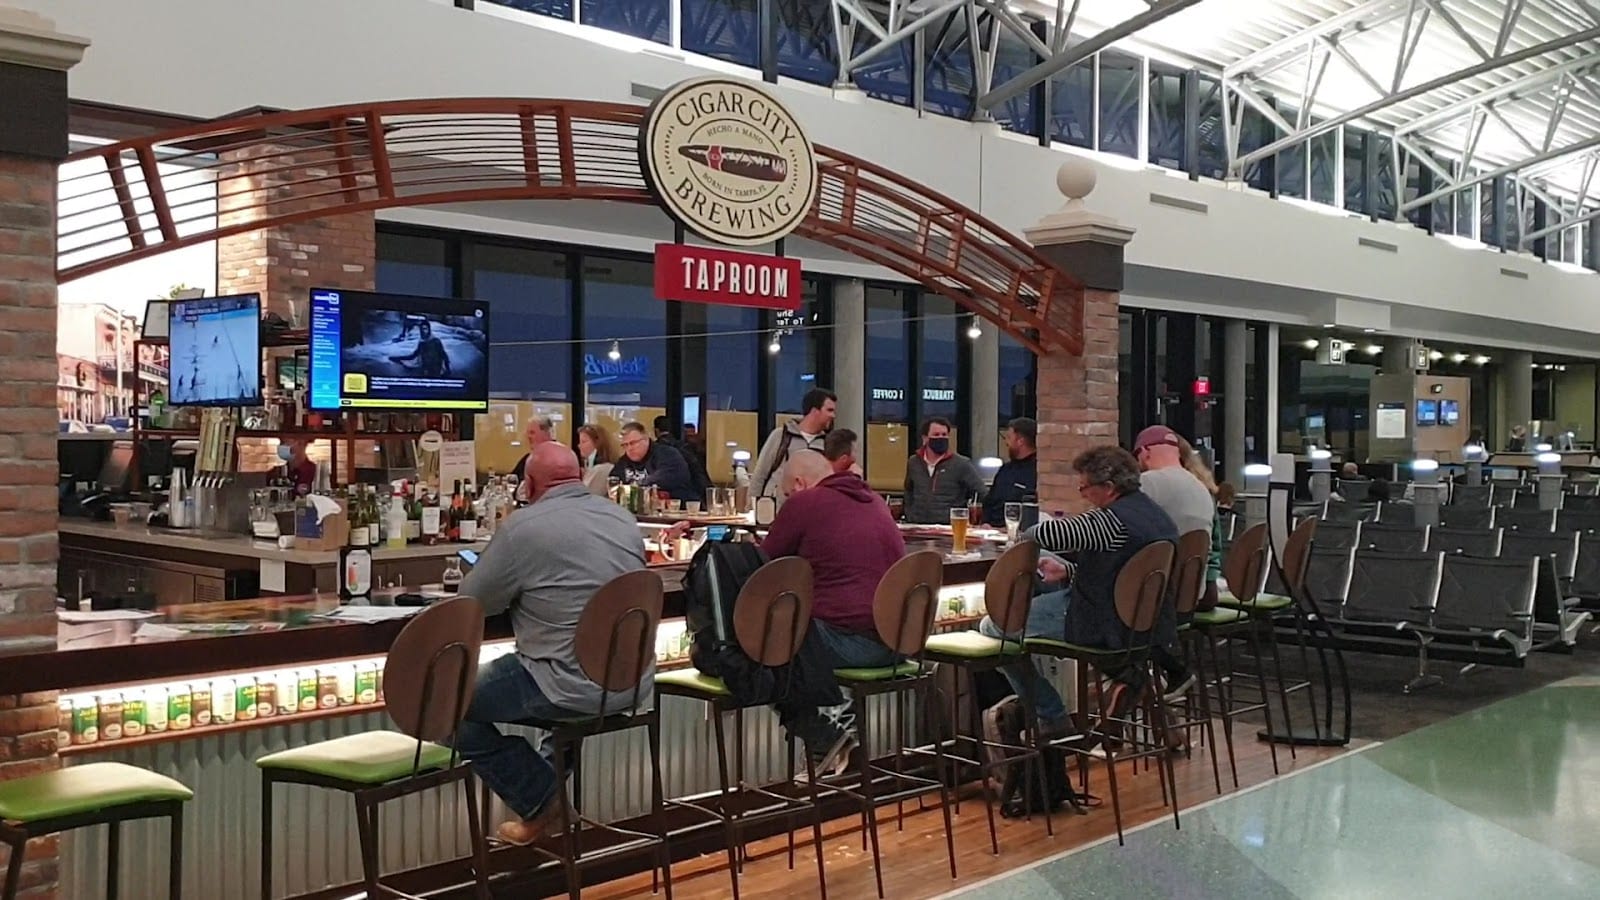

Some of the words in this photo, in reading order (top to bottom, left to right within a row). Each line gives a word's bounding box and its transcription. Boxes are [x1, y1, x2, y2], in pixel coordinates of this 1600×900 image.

[675, 90, 745, 126] CIGAR
[748, 99, 796, 145] CITY
[742, 128, 764, 145] MANO
[675, 177, 792, 230] BREWING
[702, 172, 722, 191] BORN
[724, 186, 733, 195] IN
[682, 257, 789, 298] TAPROOM
